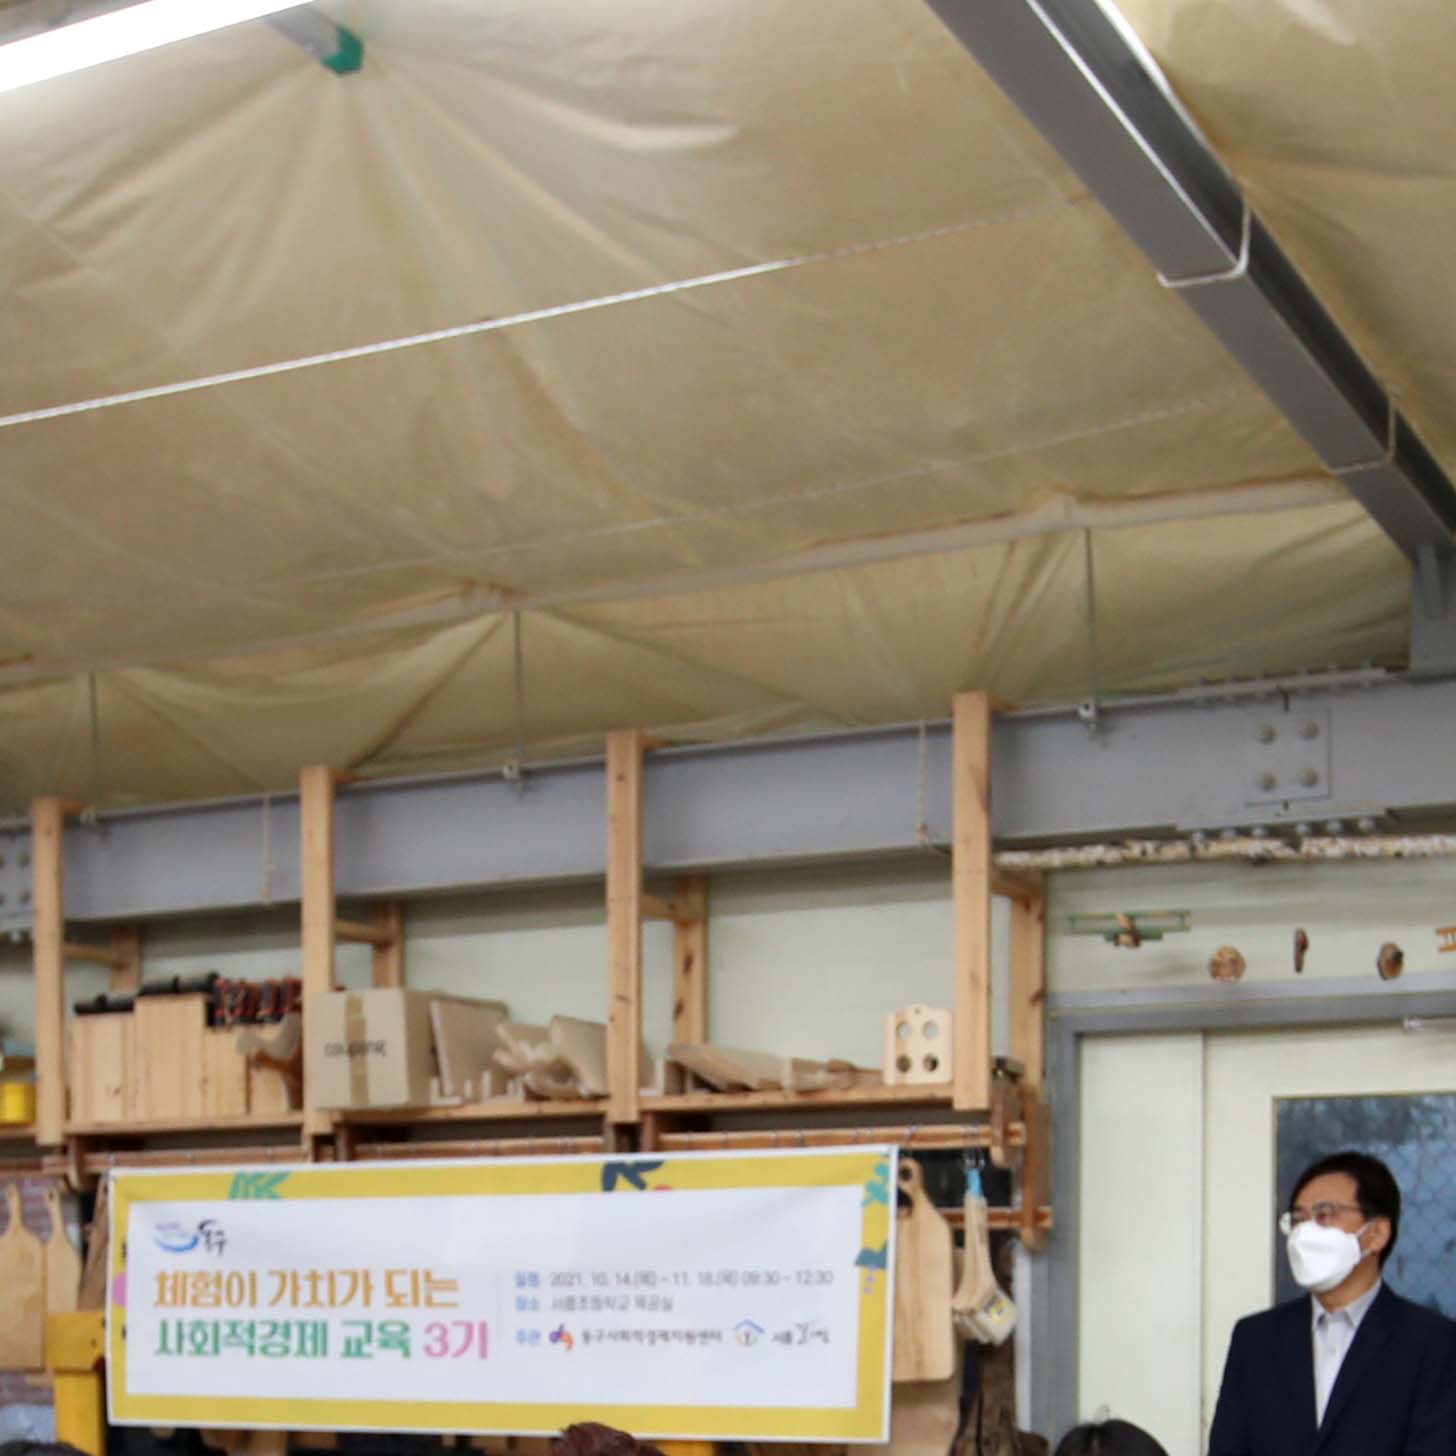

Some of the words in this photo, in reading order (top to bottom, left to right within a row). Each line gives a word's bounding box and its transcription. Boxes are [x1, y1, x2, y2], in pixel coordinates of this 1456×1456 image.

[153, 1268, 258, 1308] 체험이
[267, 1268, 374, 1308] 가치가
[383, 1267, 460, 1309] 되는
[153, 1318, 328, 1359] 사회적경제
[338, 1318, 411, 1360] 교육
[423, 1319, 488, 1361] 3기
